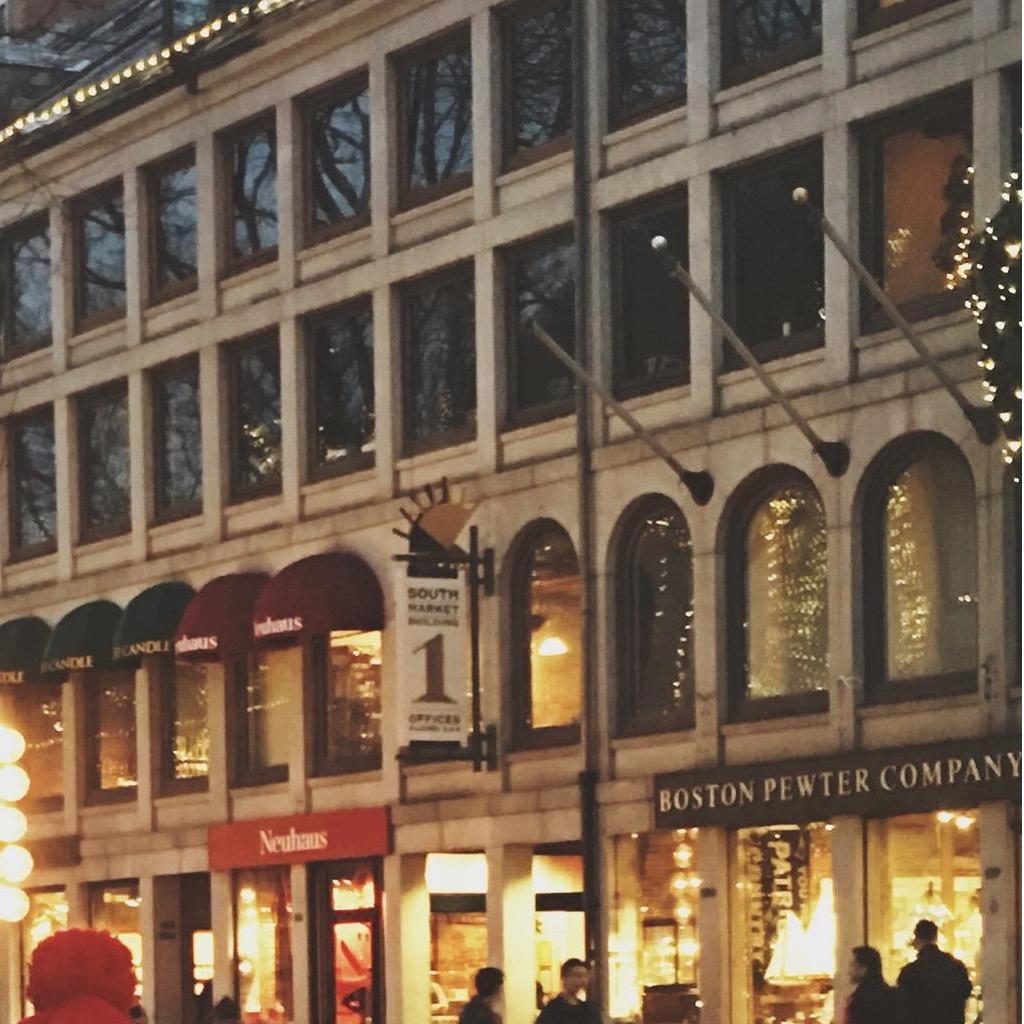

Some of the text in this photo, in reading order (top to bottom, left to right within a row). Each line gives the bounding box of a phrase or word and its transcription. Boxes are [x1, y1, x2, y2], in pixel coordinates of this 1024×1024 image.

[408, 587, 459, 600] SOUTH
[408, 604, 459, 615] MARKET
[412, 633, 457, 704] 1
[659, 751, 1022, 813] BOSTON PEWTER COMPANY
[259, 827, 328, 856] Neuhaus
